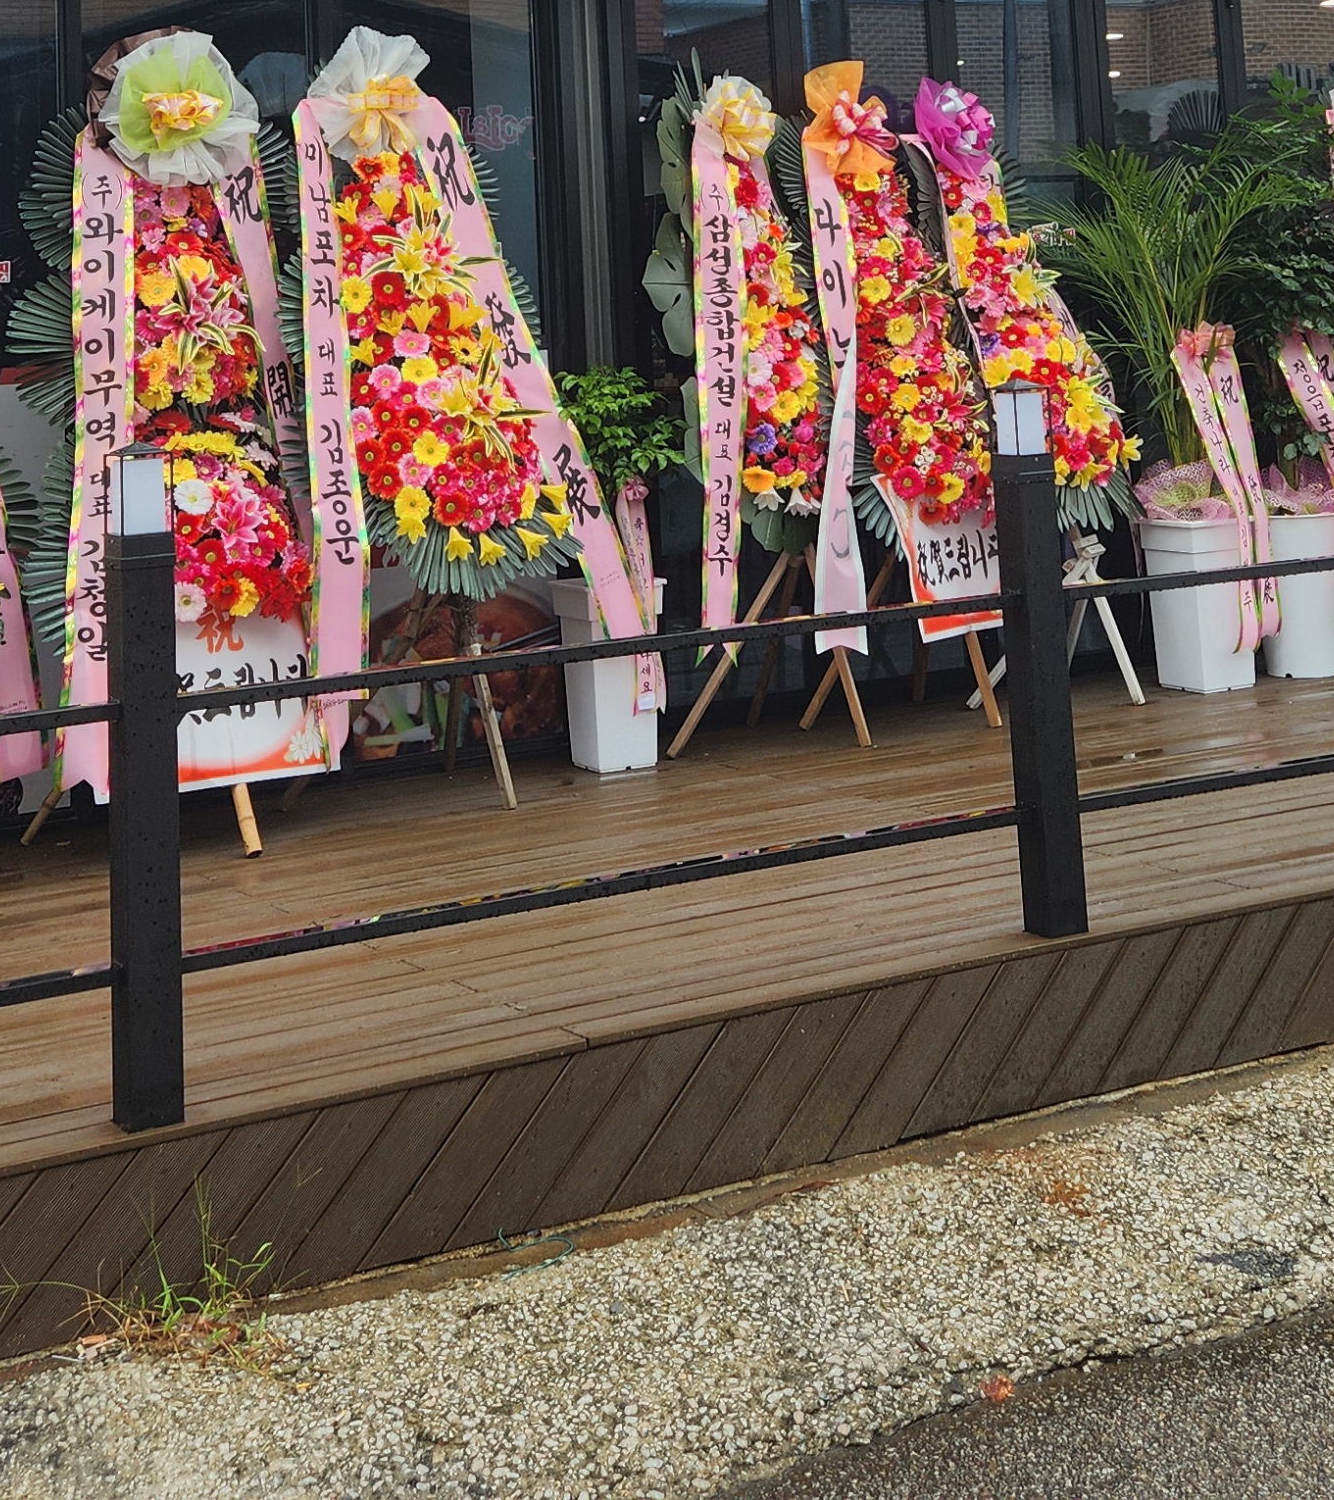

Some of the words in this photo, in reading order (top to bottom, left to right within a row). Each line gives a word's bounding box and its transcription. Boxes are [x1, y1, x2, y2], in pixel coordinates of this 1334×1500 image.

[224, 166, 263, 224] 祝
[304, 141, 340, 319] 미남포차
[317, 342, 338, 398] 대표
[714, 418, 733, 461] 대표
[320, 421, 360, 565] 김종운
[708, 474, 734, 578] 김경수
